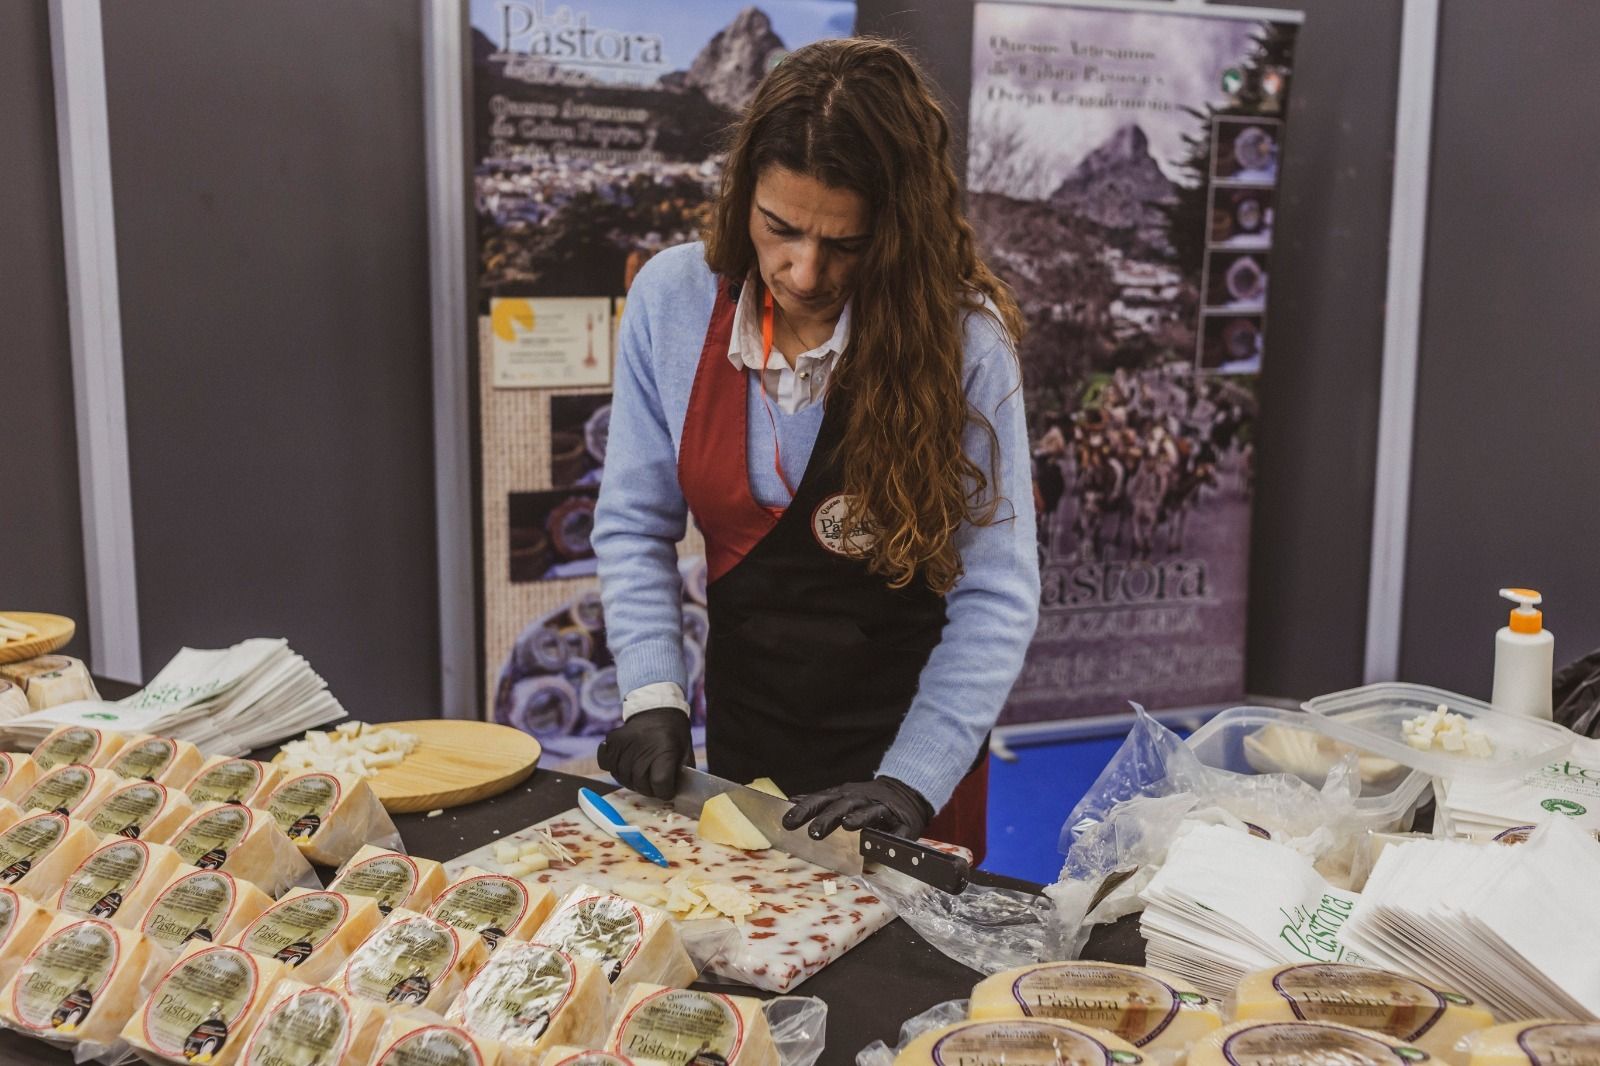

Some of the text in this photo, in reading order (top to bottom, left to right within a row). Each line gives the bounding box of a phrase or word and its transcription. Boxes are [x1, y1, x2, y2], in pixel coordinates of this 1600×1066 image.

[500, 4, 665, 64] Pastora
[1038, 558, 1212, 606] astora
[151, 914, 190, 937] Pastora
[253, 925, 293, 945] Pastora
[1280, 894, 1354, 963] Pastora
[156, 994, 202, 1024] Pastora
[1036, 993, 1120, 1010] Pastora
[628, 1034, 688, 1061] Pastora
